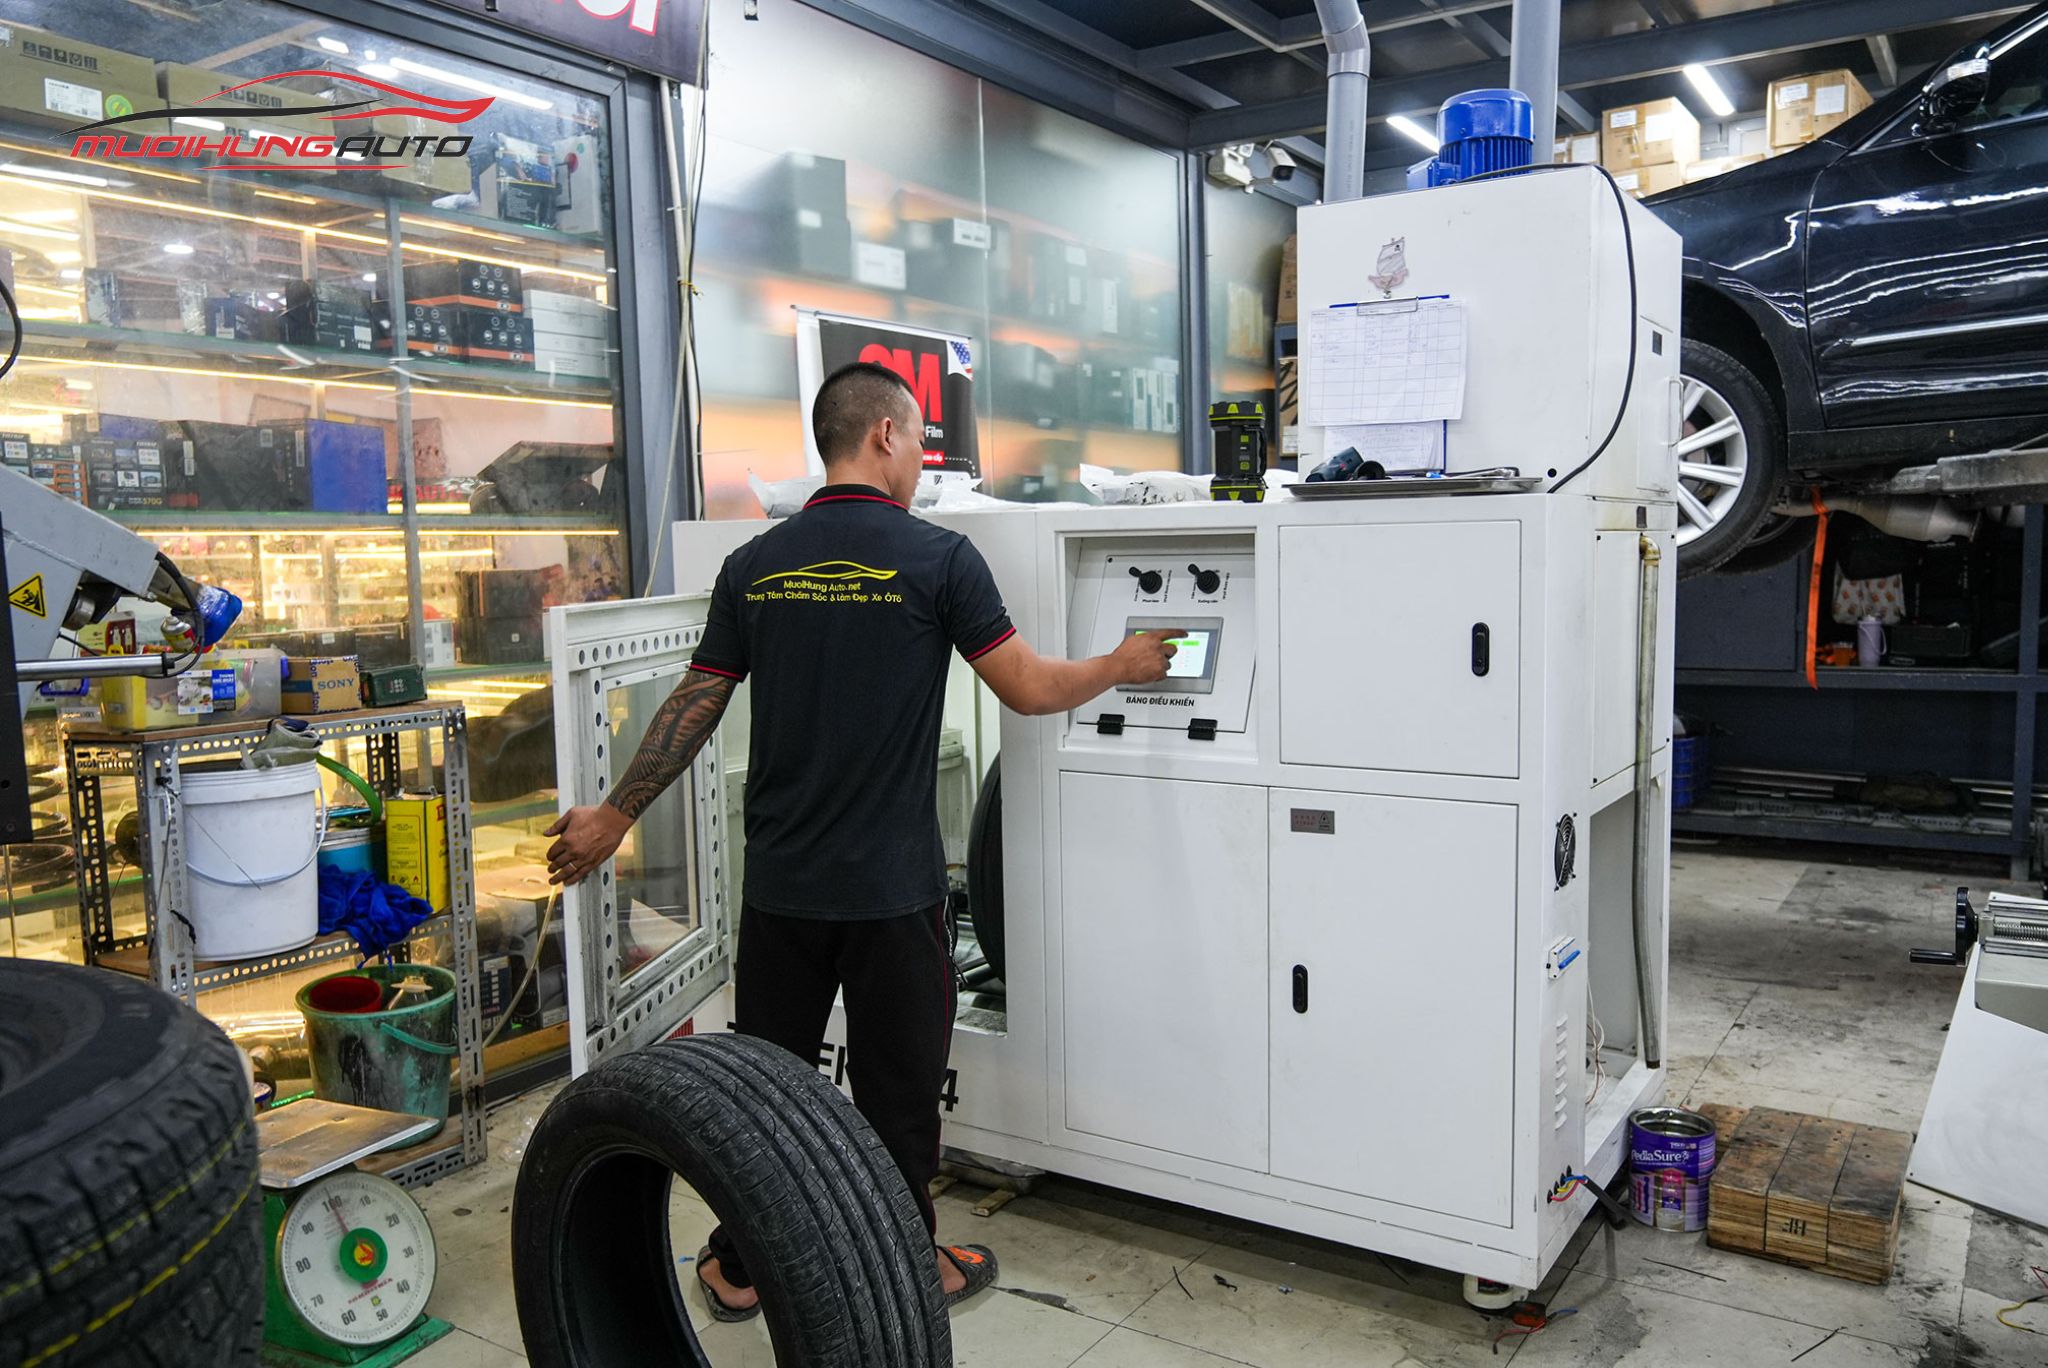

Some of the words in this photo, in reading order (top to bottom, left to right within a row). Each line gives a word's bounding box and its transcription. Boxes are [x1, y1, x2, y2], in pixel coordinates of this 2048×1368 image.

[871, 593, 883, 602] Xe
[318, 679, 354, 690] SONY
[322, 1195, 342, 1213] 100
[360, 1195, 372, 1207] 10
[386, 1213, 401, 1228] 20
[301, 1222, 315, 1235] 90
[402, 1246, 414, 1258] 30
[295, 1257, 312, 1274] 80
[397, 1279, 410, 1294] 40
[310, 1294, 325, 1308] 70
[340, 1309, 357, 1326] 60
[376, 1308, 389, 1322] 50
